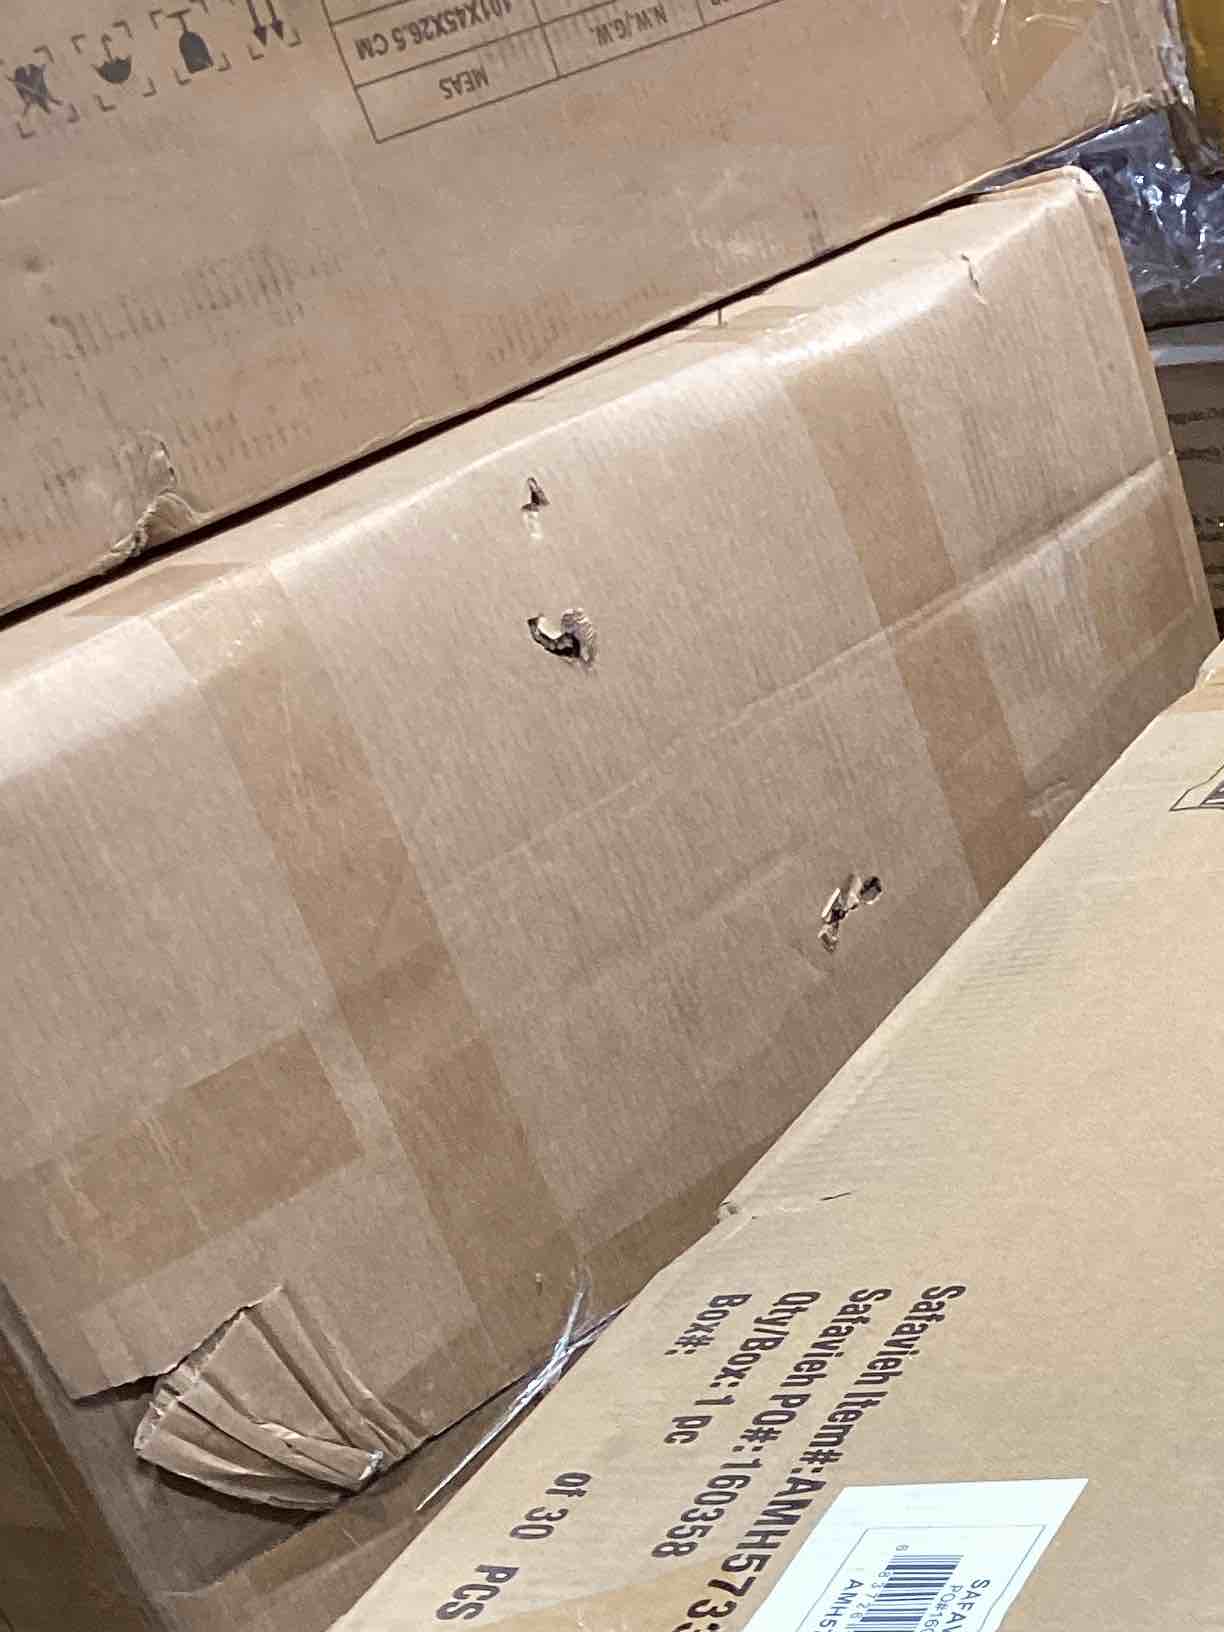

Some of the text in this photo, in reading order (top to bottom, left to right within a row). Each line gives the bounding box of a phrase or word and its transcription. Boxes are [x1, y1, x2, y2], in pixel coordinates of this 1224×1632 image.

[353, 32, 388, 60] CM
[440, 64, 489, 99] MEAS
[709, 1290, 821, 1388] Qty/Box:
[853, 1284, 966, 1385] Safavieh
[436, 1293, 752, 1621] Box#: of 30 PCS
[651, 1288, 891, 1558] Safavieh PO#:160358
[664, 1414, 712, 1445] pc
